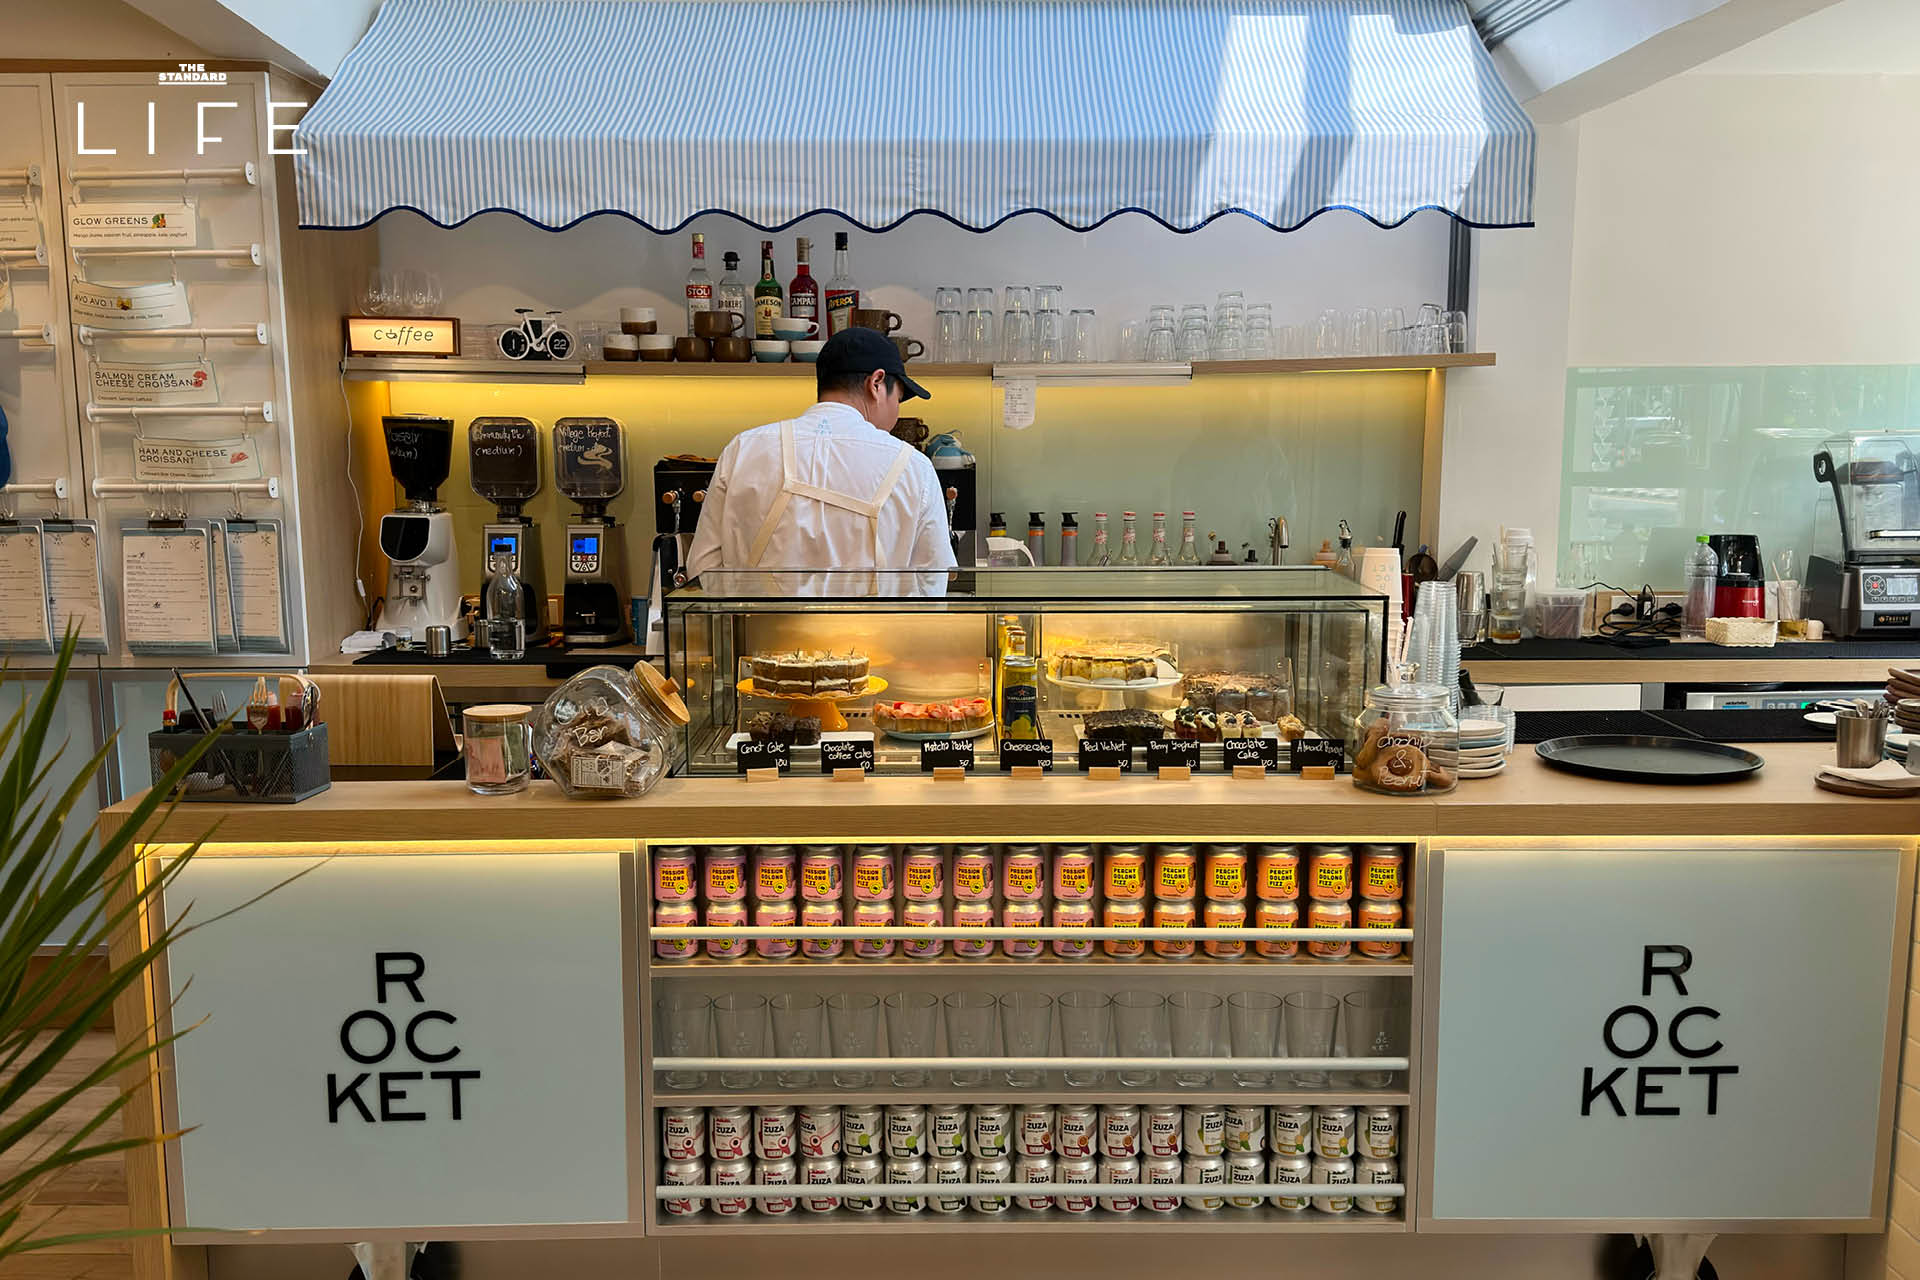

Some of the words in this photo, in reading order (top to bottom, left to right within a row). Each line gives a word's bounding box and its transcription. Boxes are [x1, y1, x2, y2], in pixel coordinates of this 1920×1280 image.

[73, 217, 101, 226] GLOW
[105, 216, 149, 226] GREENS
[687, 287, 711, 296] STOLI
[74, 295, 88, 304] AVO
[90, 297, 107, 307] AVO
[828, 295, 855, 310] APEROL
[373, 326, 434, 345] coffee
[553, 338, 568, 350] 22
[95, 371, 134, 381] SALMON
[137, 372, 175, 382] CREAM
[96, 379, 135, 389] CHEESE
[138, 447, 159, 456] HAM
[162, 448, 183, 457] AND
[185, 448, 228, 458] CHEESE
[139, 455, 194, 464] CROISSANT
[573, 722, 608, 747] Bar
[1083, 741, 1099, 752] Red
[828, 751, 852, 760] coffee
[854, 749, 873, 759] cake
[1237, 750, 1260, 760] Cake
[1642, 945, 1693, 996] R
[375, 951, 425, 1004] R
[1603, 1004, 1725, 1059] OC
[340, 1009, 461, 1064] OC
[1581, 1065, 1739, 1117] KET
[327, 1070, 481, 1123] KET
[764, 1125, 784, 1133] ZUZA
[846, 1121, 865, 1130] ZUZA
[892, 1124, 913, 1132] ZUZA
[937, 1123, 958, 1131] ZUZA
[980, 1124, 1001, 1132] ZUZA
[1026, 1122, 1047, 1130] ZUZA
[1063, 1123, 1084, 1132] ZUZA
[1108, 1124, 1129, 1132] ZUZA
[1153, 1123, 1174, 1131] ZUZA
[1278, 1121, 1299, 1129] ZUZA
[1321, 1123, 1343, 1132] ZUZA
[1372, 1124, 1393, 1132] ZUZA
[669, 1126, 689, 1134] ZUZA
[811, 1177, 832, 1185] ZUZA
[845, 1175, 866, 1185] ZUZA
[1029, 1175, 1050, 1184] ZUZA
[1233, 1173, 1255, 1181] ZUZA
[1279, 1175, 1301, 1184] ZUZA
